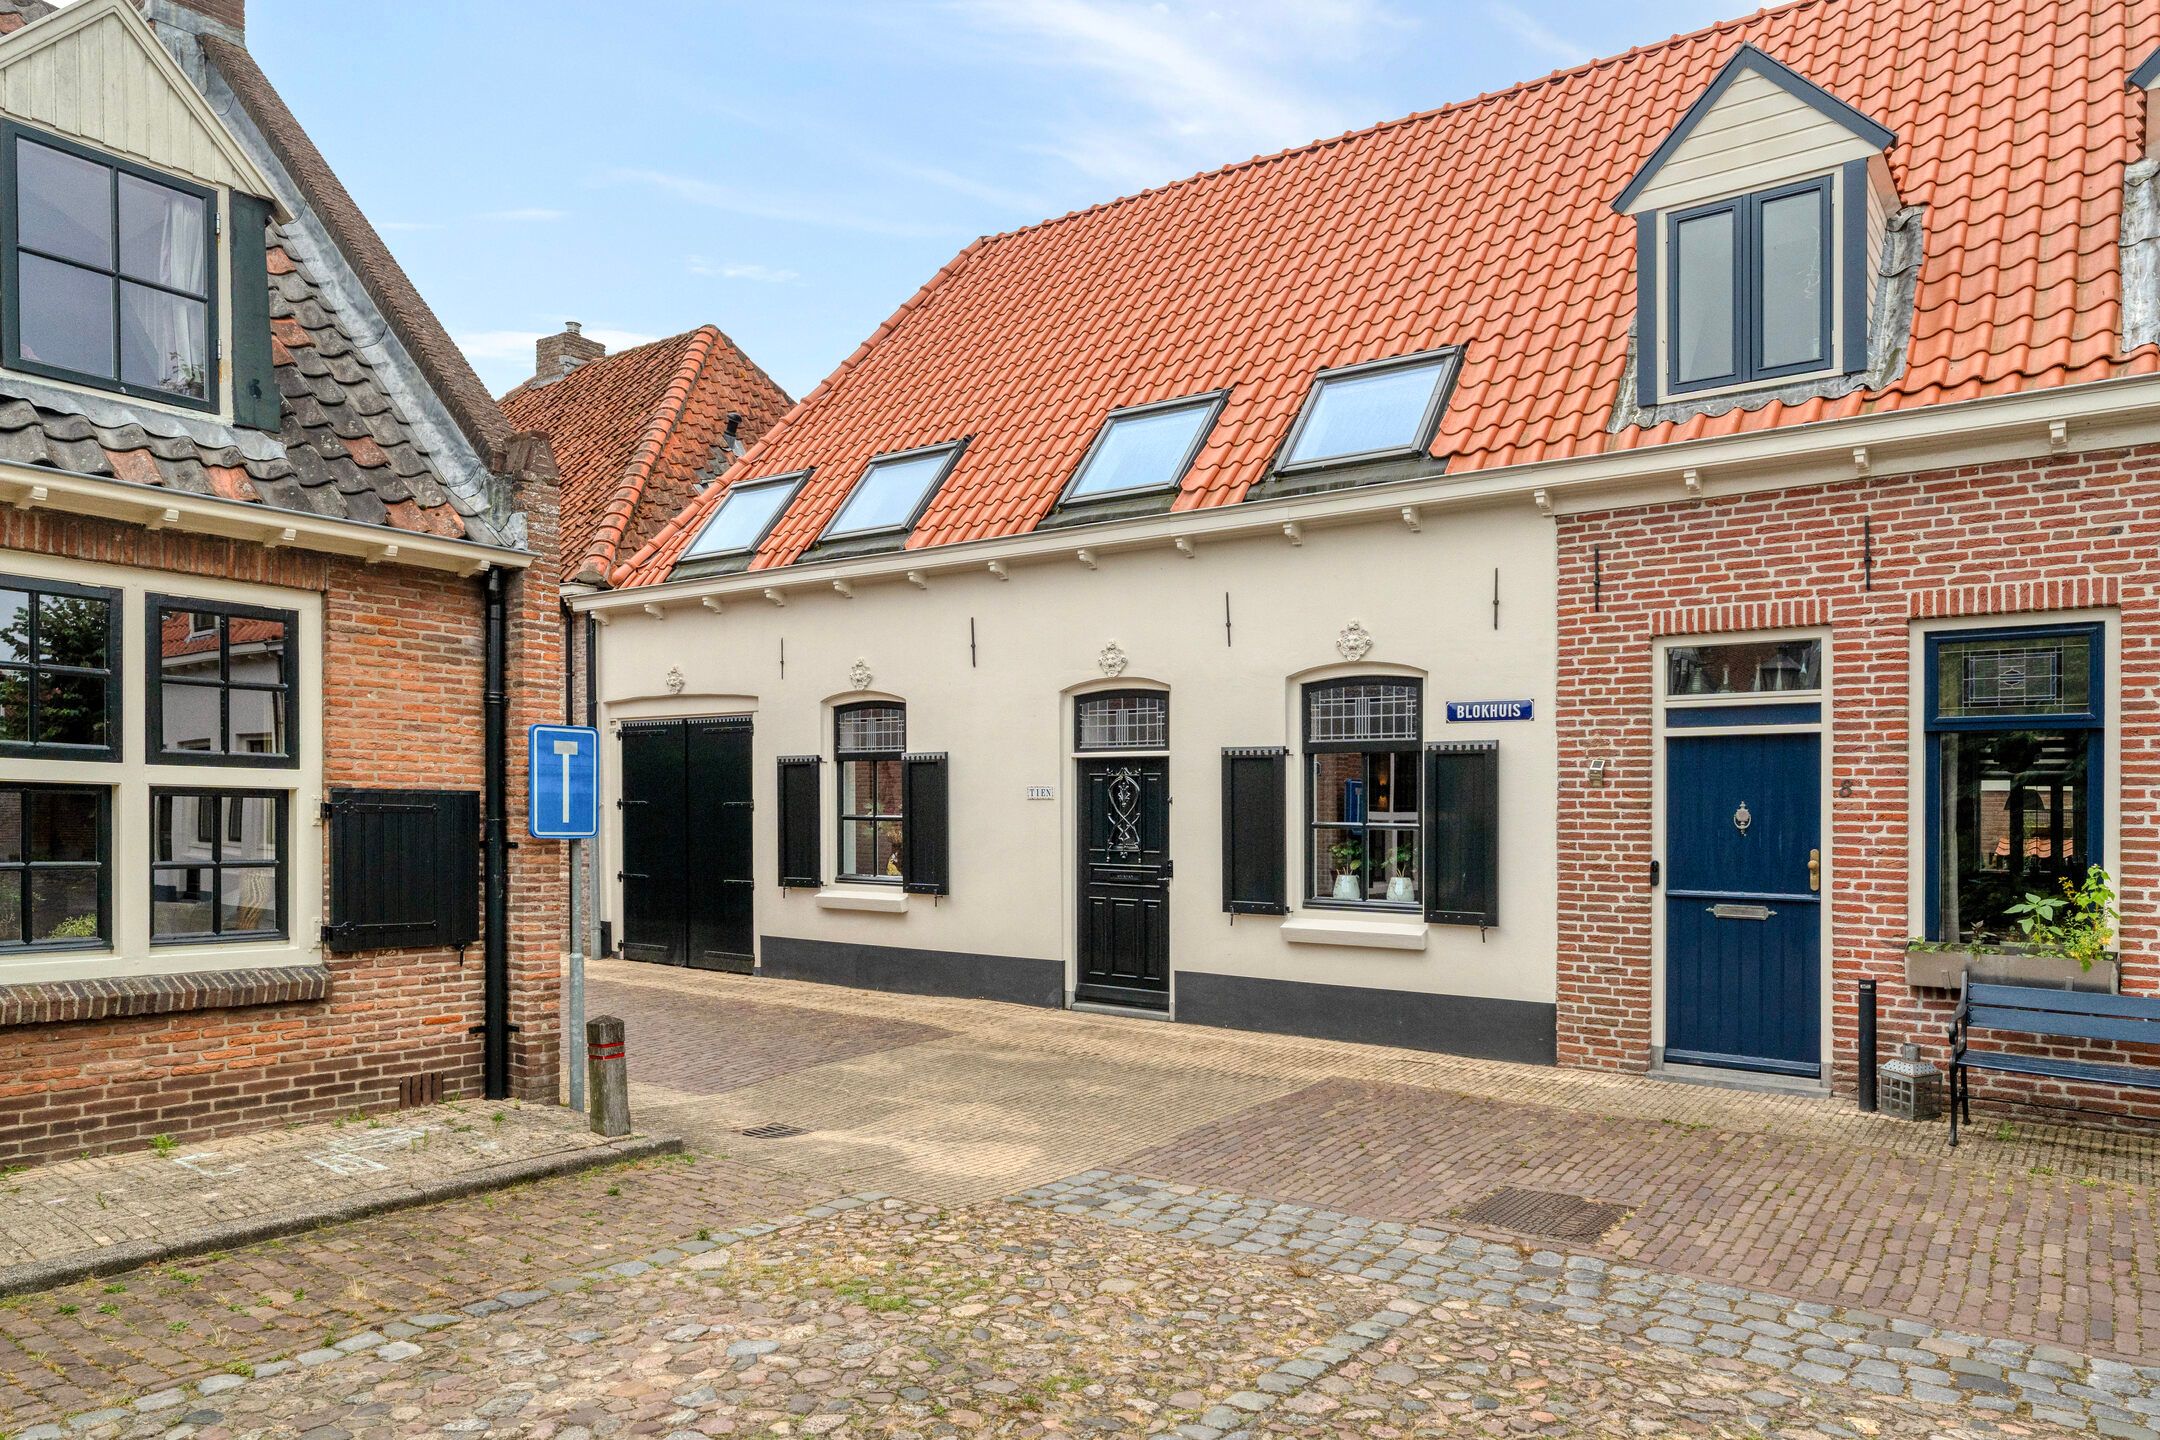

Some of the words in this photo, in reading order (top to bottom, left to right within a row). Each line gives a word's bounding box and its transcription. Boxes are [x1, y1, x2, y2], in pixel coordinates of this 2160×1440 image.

[1457, 704, 1521, 718] BLOKHUIS
[1029, 788, 1051, 797] TIEN
[1839, 778, 1852, 798] 8
